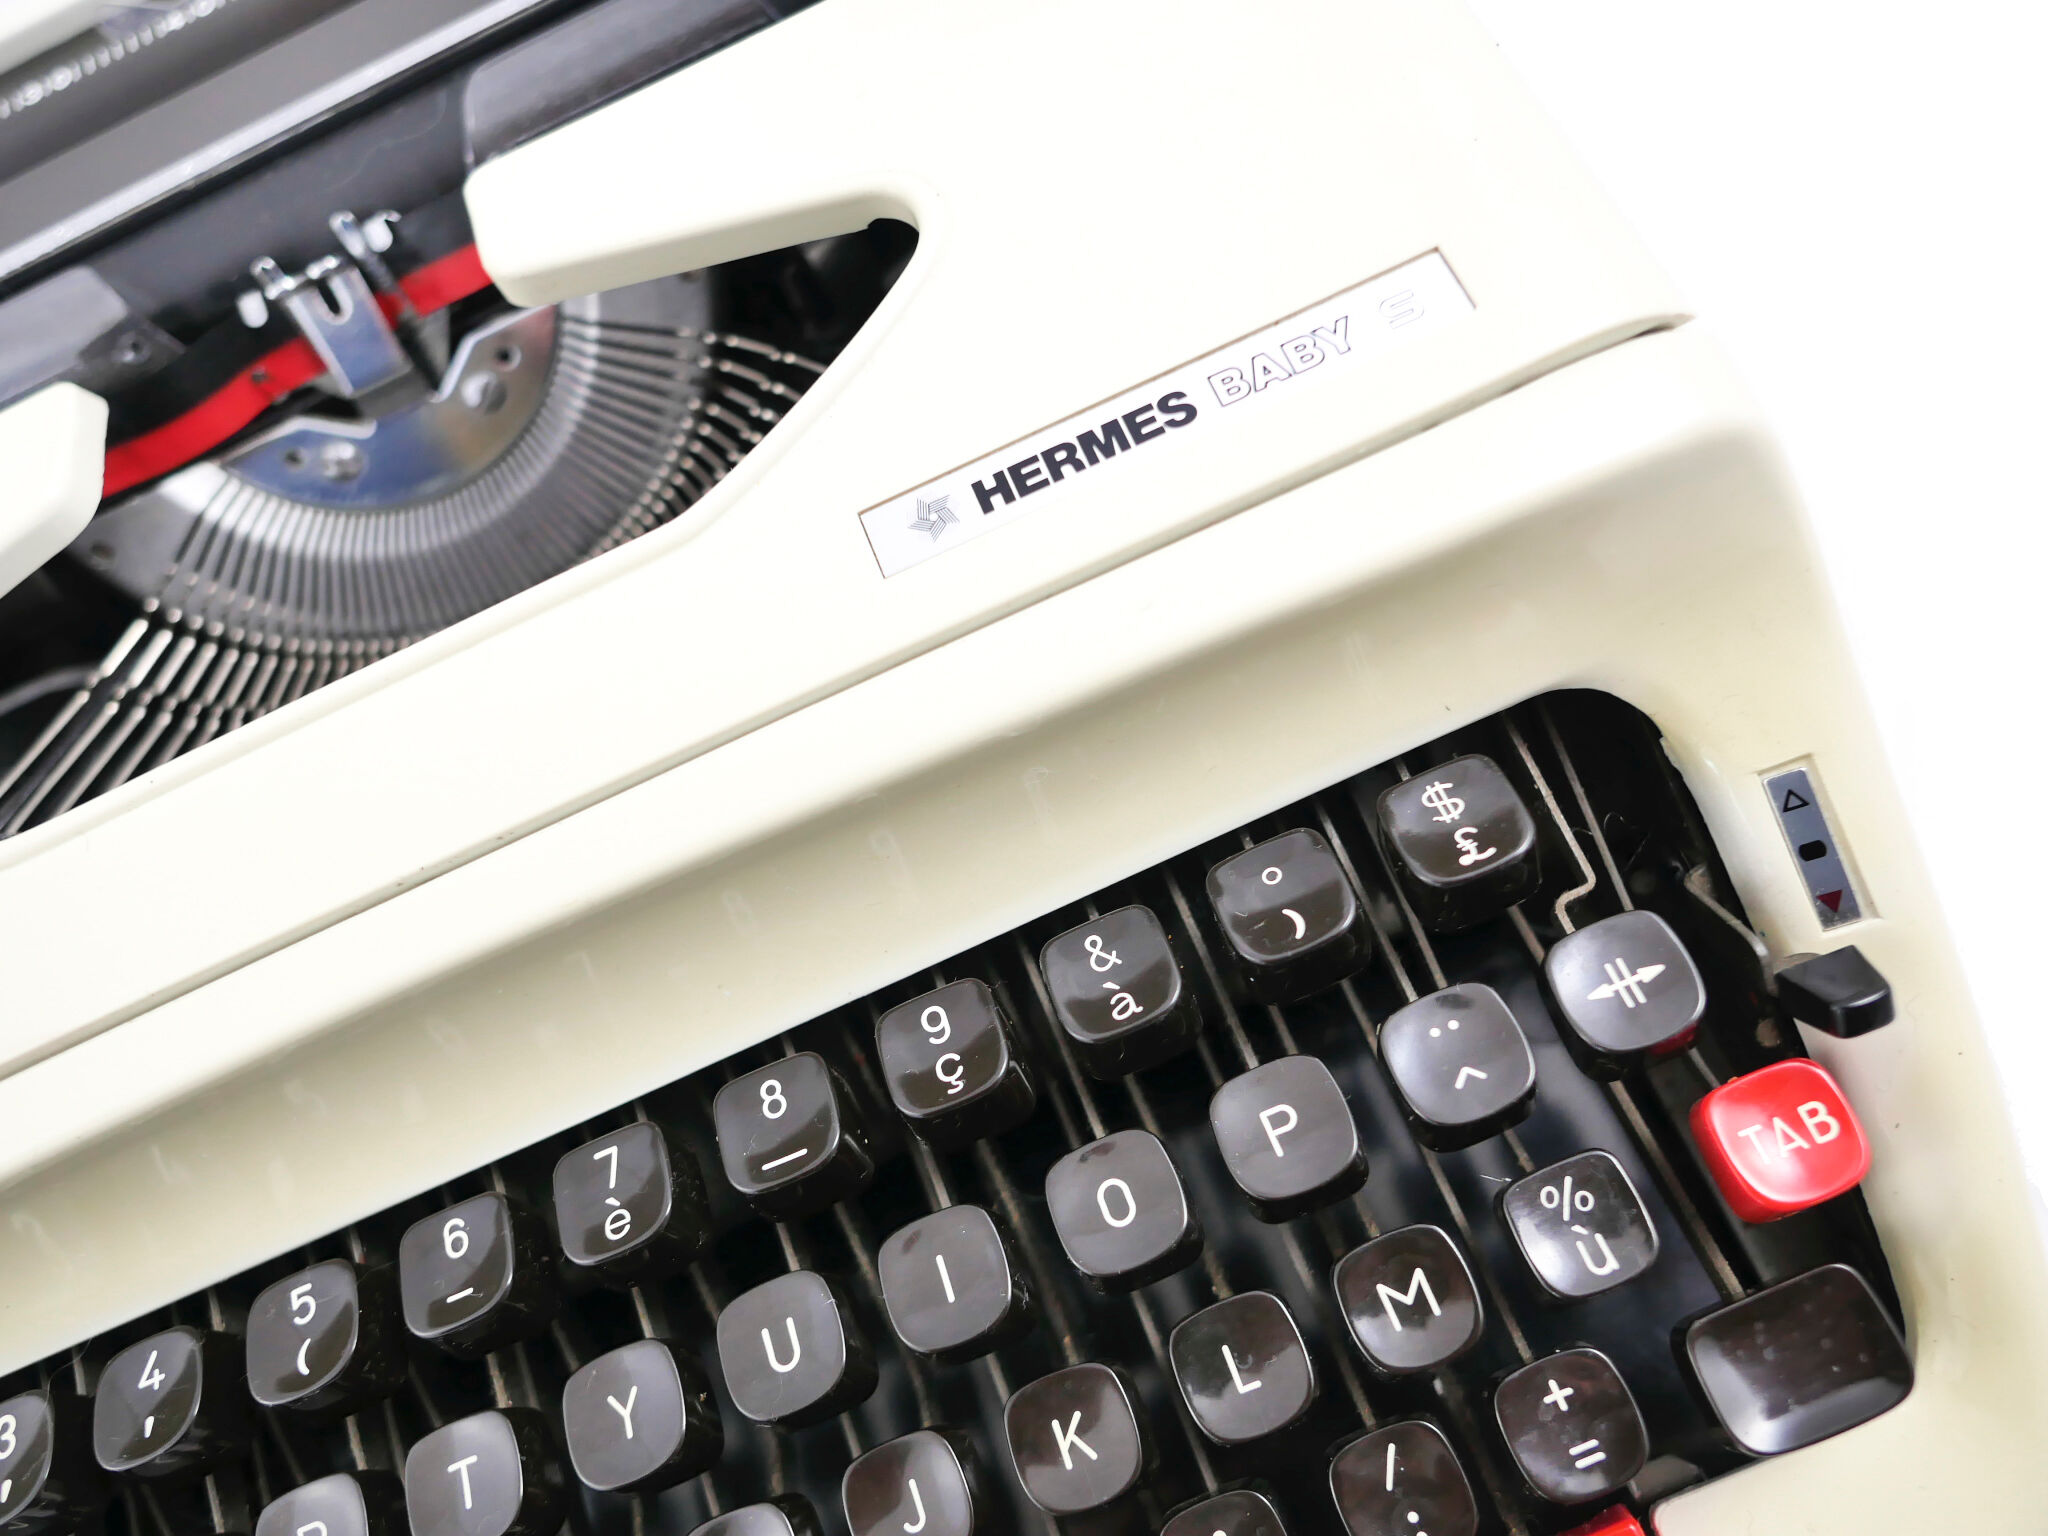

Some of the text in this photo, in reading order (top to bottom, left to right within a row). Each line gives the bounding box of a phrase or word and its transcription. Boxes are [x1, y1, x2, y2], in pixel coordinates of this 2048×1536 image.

[970, 290, 1425, 515] HERMES BABY S
[1421, 781, 1466, 824] $
[1454, 826, 1497, 866] £
[1084, 934, 1123, 972] &
[920, 1005, 951, 1045] 9
[1102, 981, 1144, 1021] à
[935, 1052, 964, 1095] ç
[759, 1079, 788, 1120] 8
[1258, 1103, 1298, 1158] P
[1738, 1100, 1841, 1164] TAB
[593, 1145, 618, 1189] 7
[604, 1196, 631, 1241] è
[1096, 1177, 1137, 1228] O
[1539, 1175, 1595, 1222] %
[443, 1217, 469, 1259] 6
[1571, 1224, 1620, 1276] ù
[935, 1254, 956, 1304] I
[1375, 1267, 1442, 1332] M
[290, 1282, 316, 1325] 5
[760, 1316, 801, 1373] U
[137, 1350, 166, 1391] 4
[1221, 1344, 1262, 1394] L
[606, 1385, 638, 1440] Y
[1051, 1410, 1098, 1471] K
[447, 1454, 478, 1510] T
[903, 1478, 927, 1534] J
